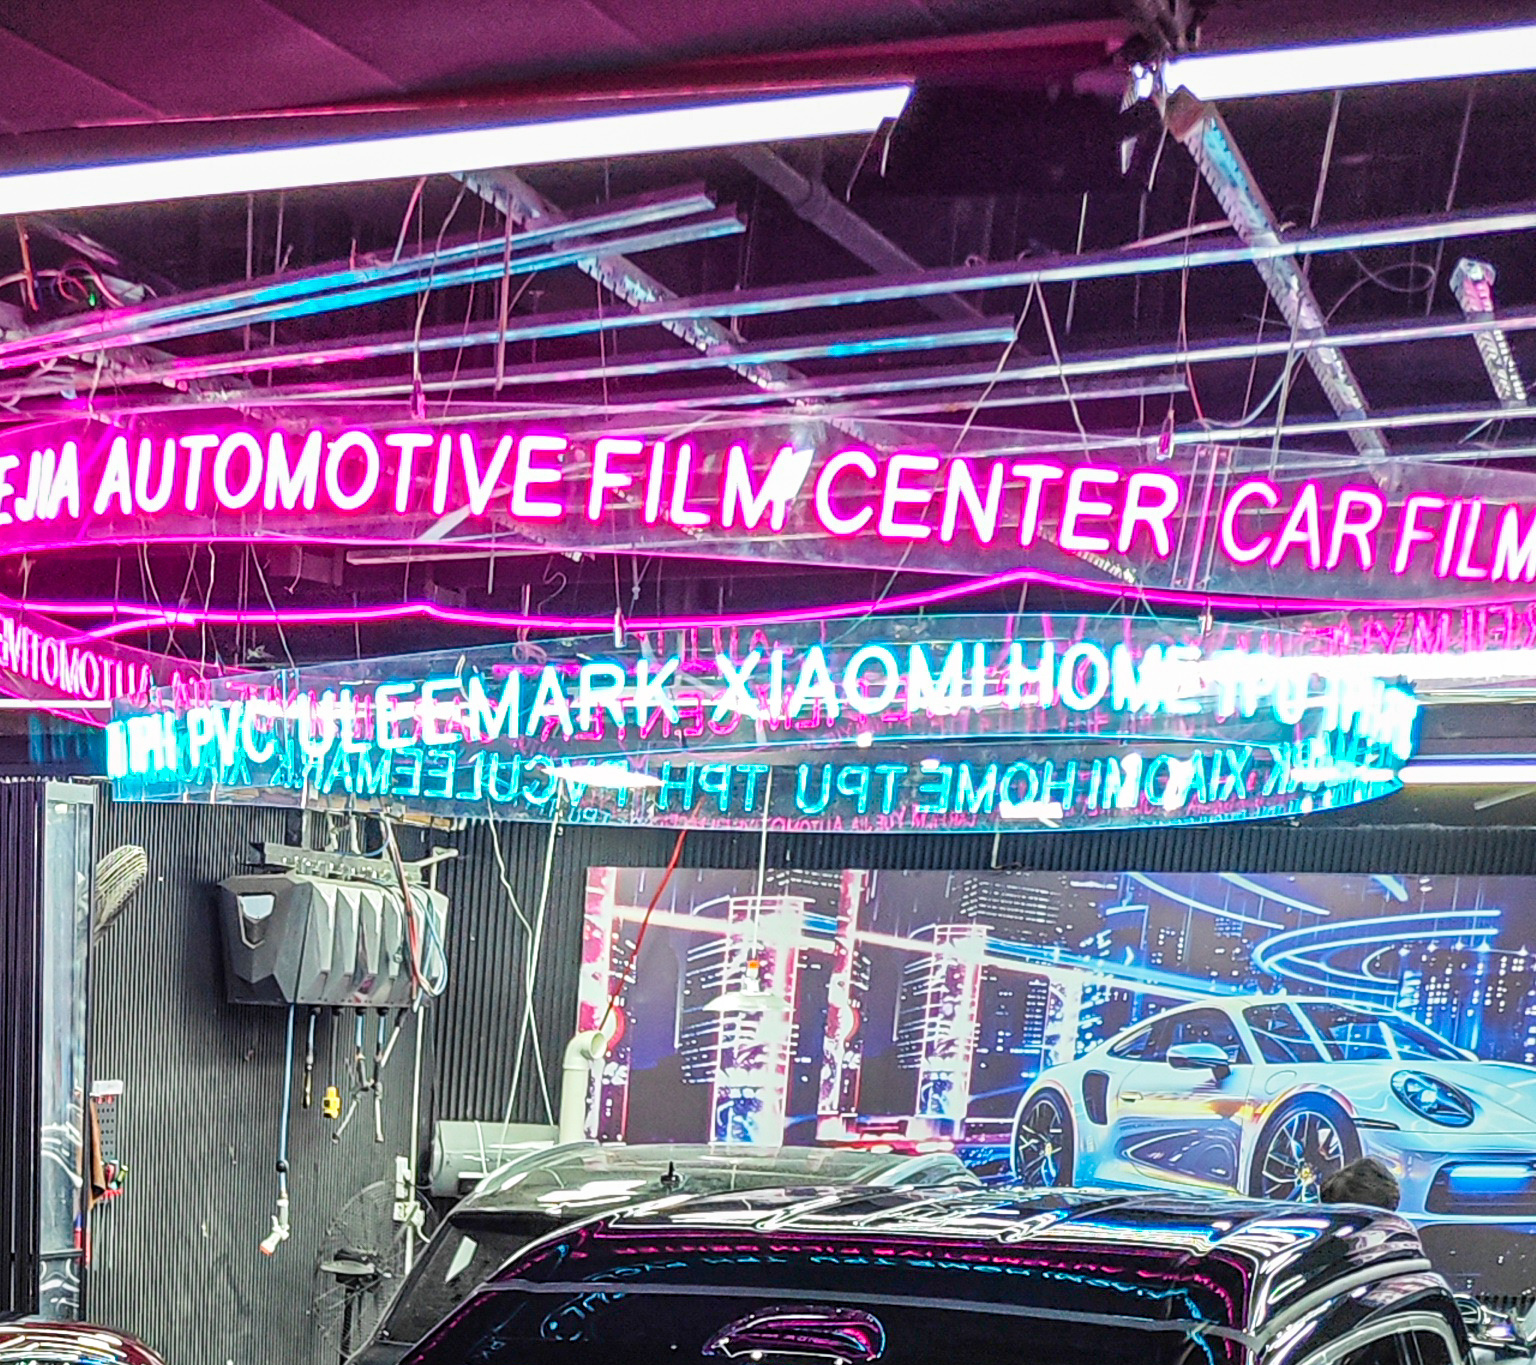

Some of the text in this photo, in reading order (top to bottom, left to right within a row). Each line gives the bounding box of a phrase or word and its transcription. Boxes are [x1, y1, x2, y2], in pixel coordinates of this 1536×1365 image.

[93, 430, 567, 520] AUTOMOTIVE
[590, 437, 814, 531] FILM
[814, 446, 1181, 558] CENTER
[1220, 479, 1536, 582] CAR FILM
[715, 642, 990, 721] XIAOMI
